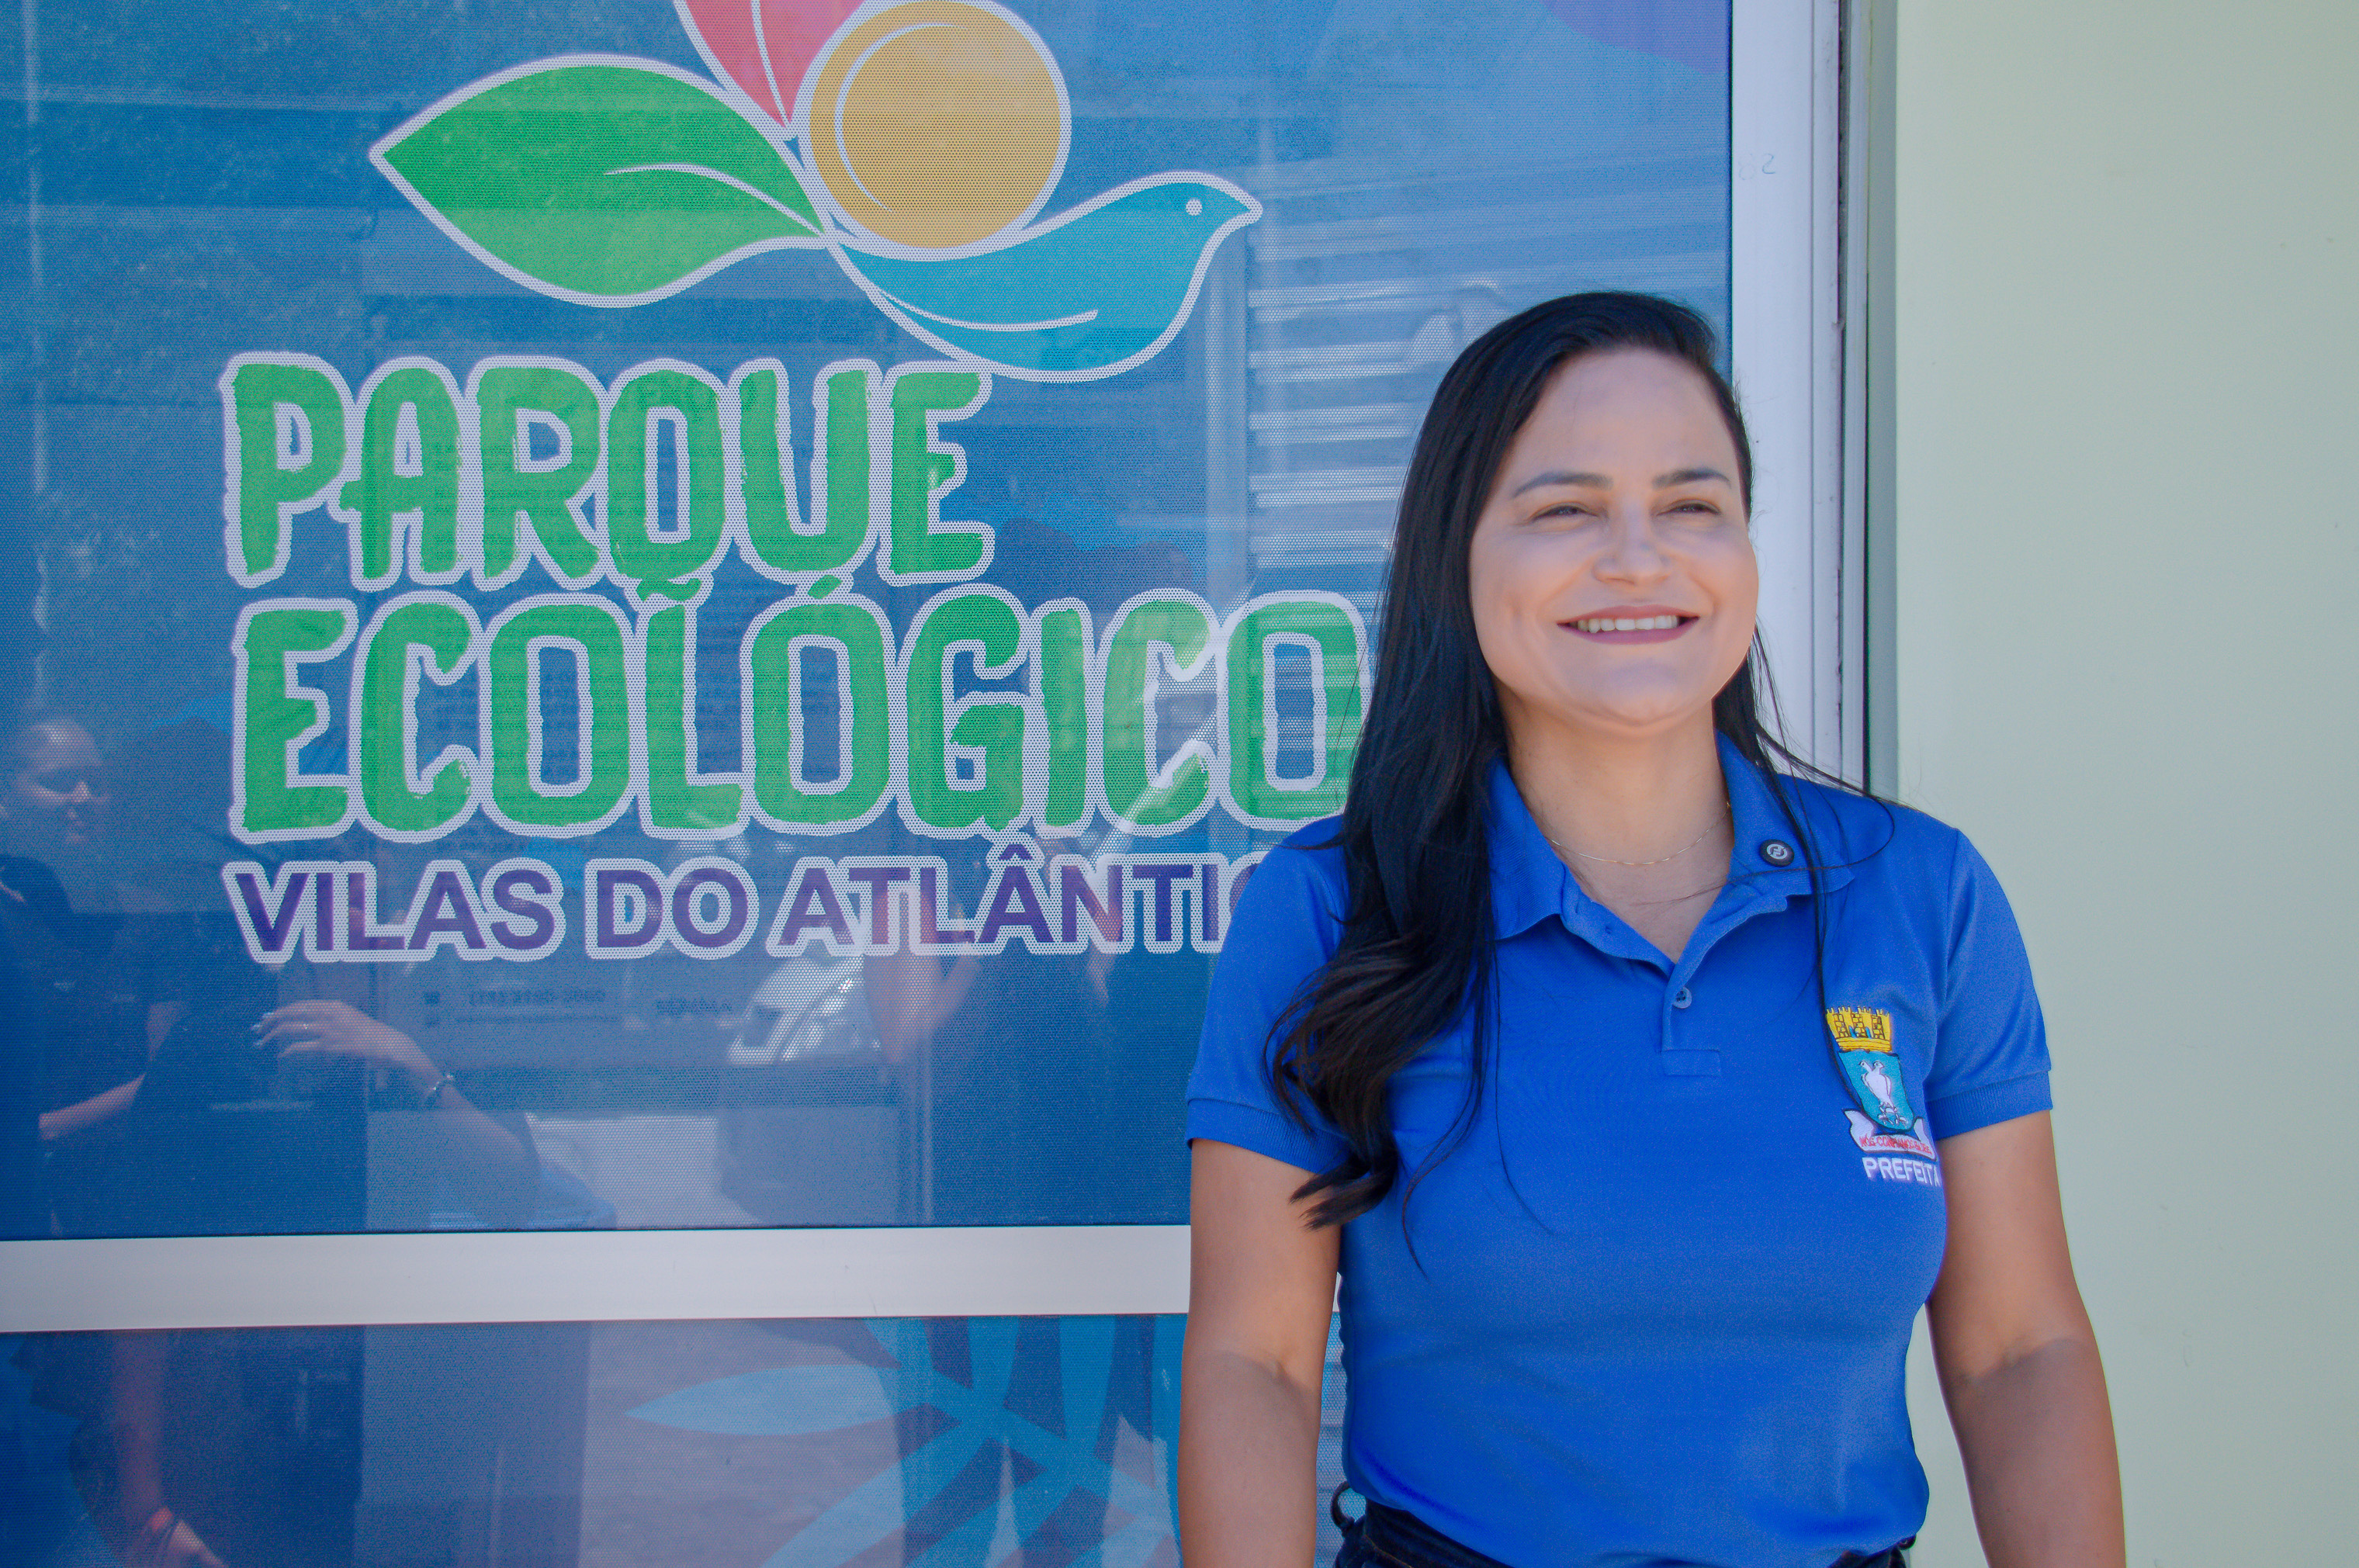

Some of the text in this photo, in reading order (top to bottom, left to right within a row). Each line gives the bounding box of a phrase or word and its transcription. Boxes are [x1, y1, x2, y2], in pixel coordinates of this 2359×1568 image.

[223, 355, 992, 597] PARQUE
[237, 576, 1369, 838] ECOLÓGICO
[230, 864, 560, 956] VILAS
[590, 863, 753, 956] DO
